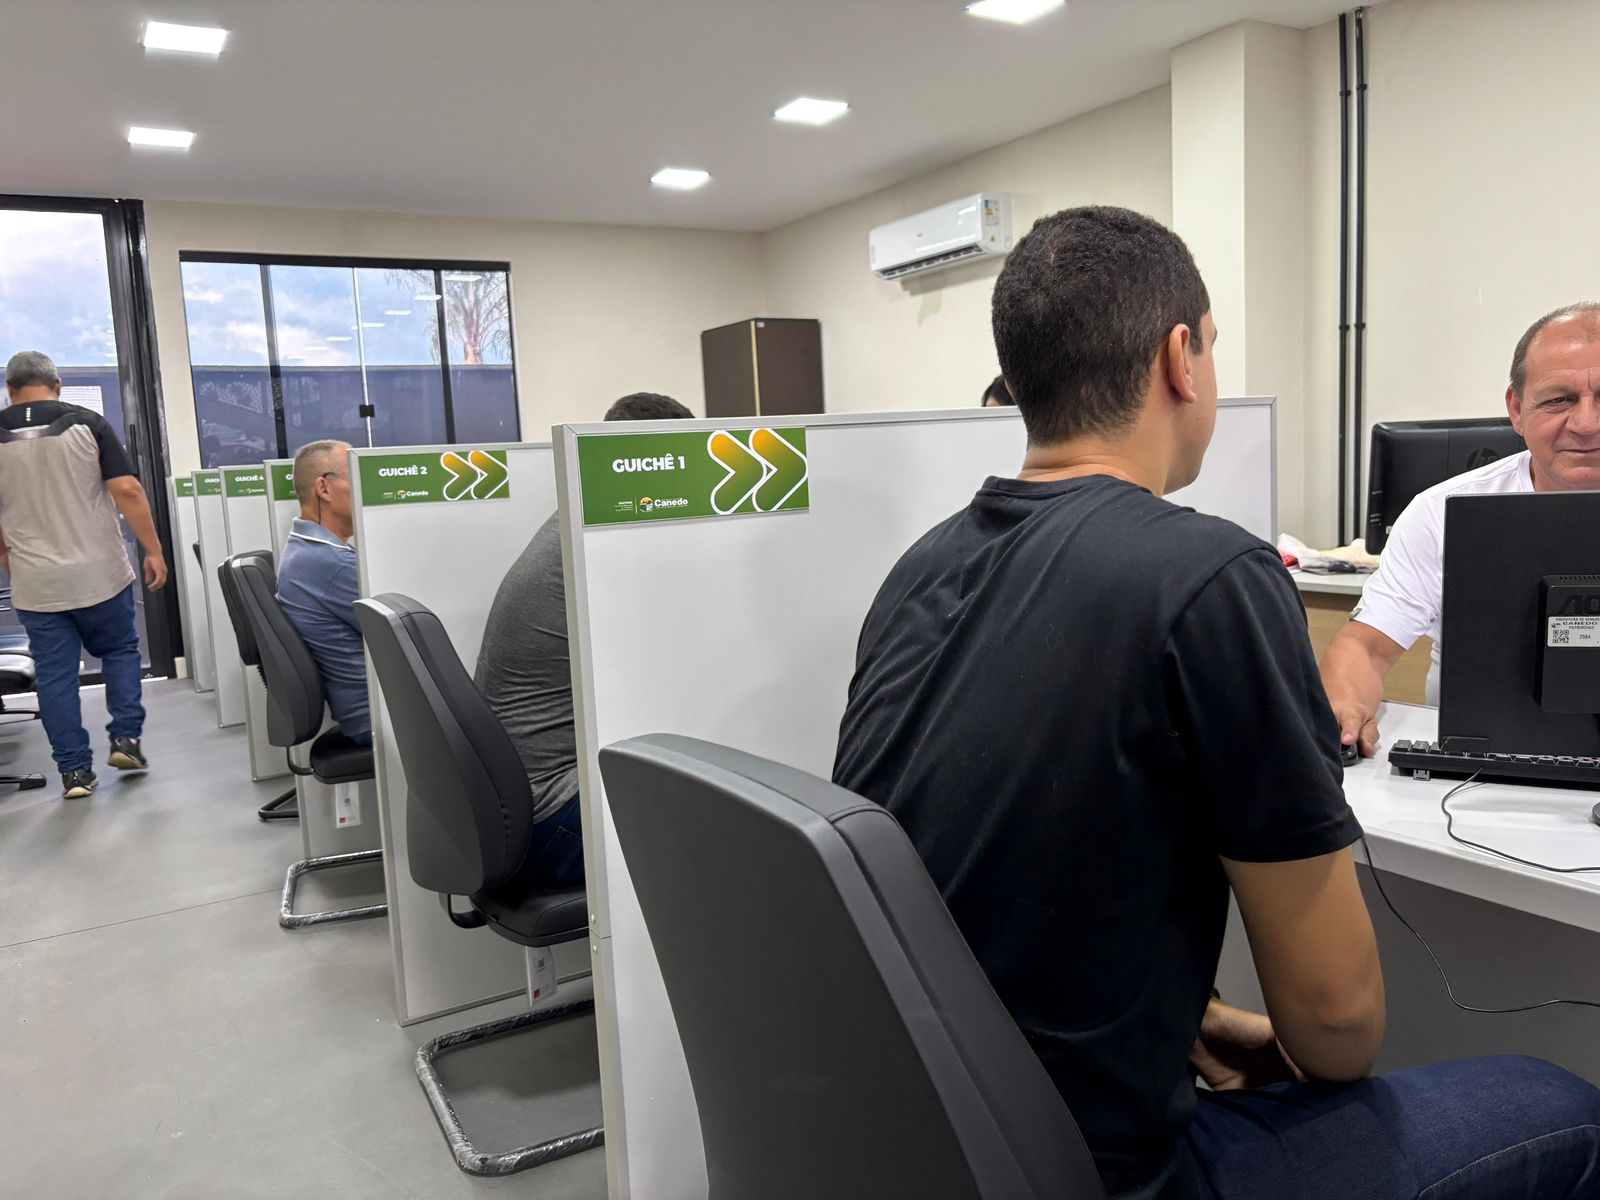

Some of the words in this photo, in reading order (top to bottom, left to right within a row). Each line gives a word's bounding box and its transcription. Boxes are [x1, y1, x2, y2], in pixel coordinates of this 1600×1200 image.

[612, 453, 675, 473] GUICHÊ
[678, 456, 686, 470] 1
[379, 464, 419, 477] GUICHÊ
[420, 466, 428, 475] 2
[654, 497, 688, 507] Canedo
